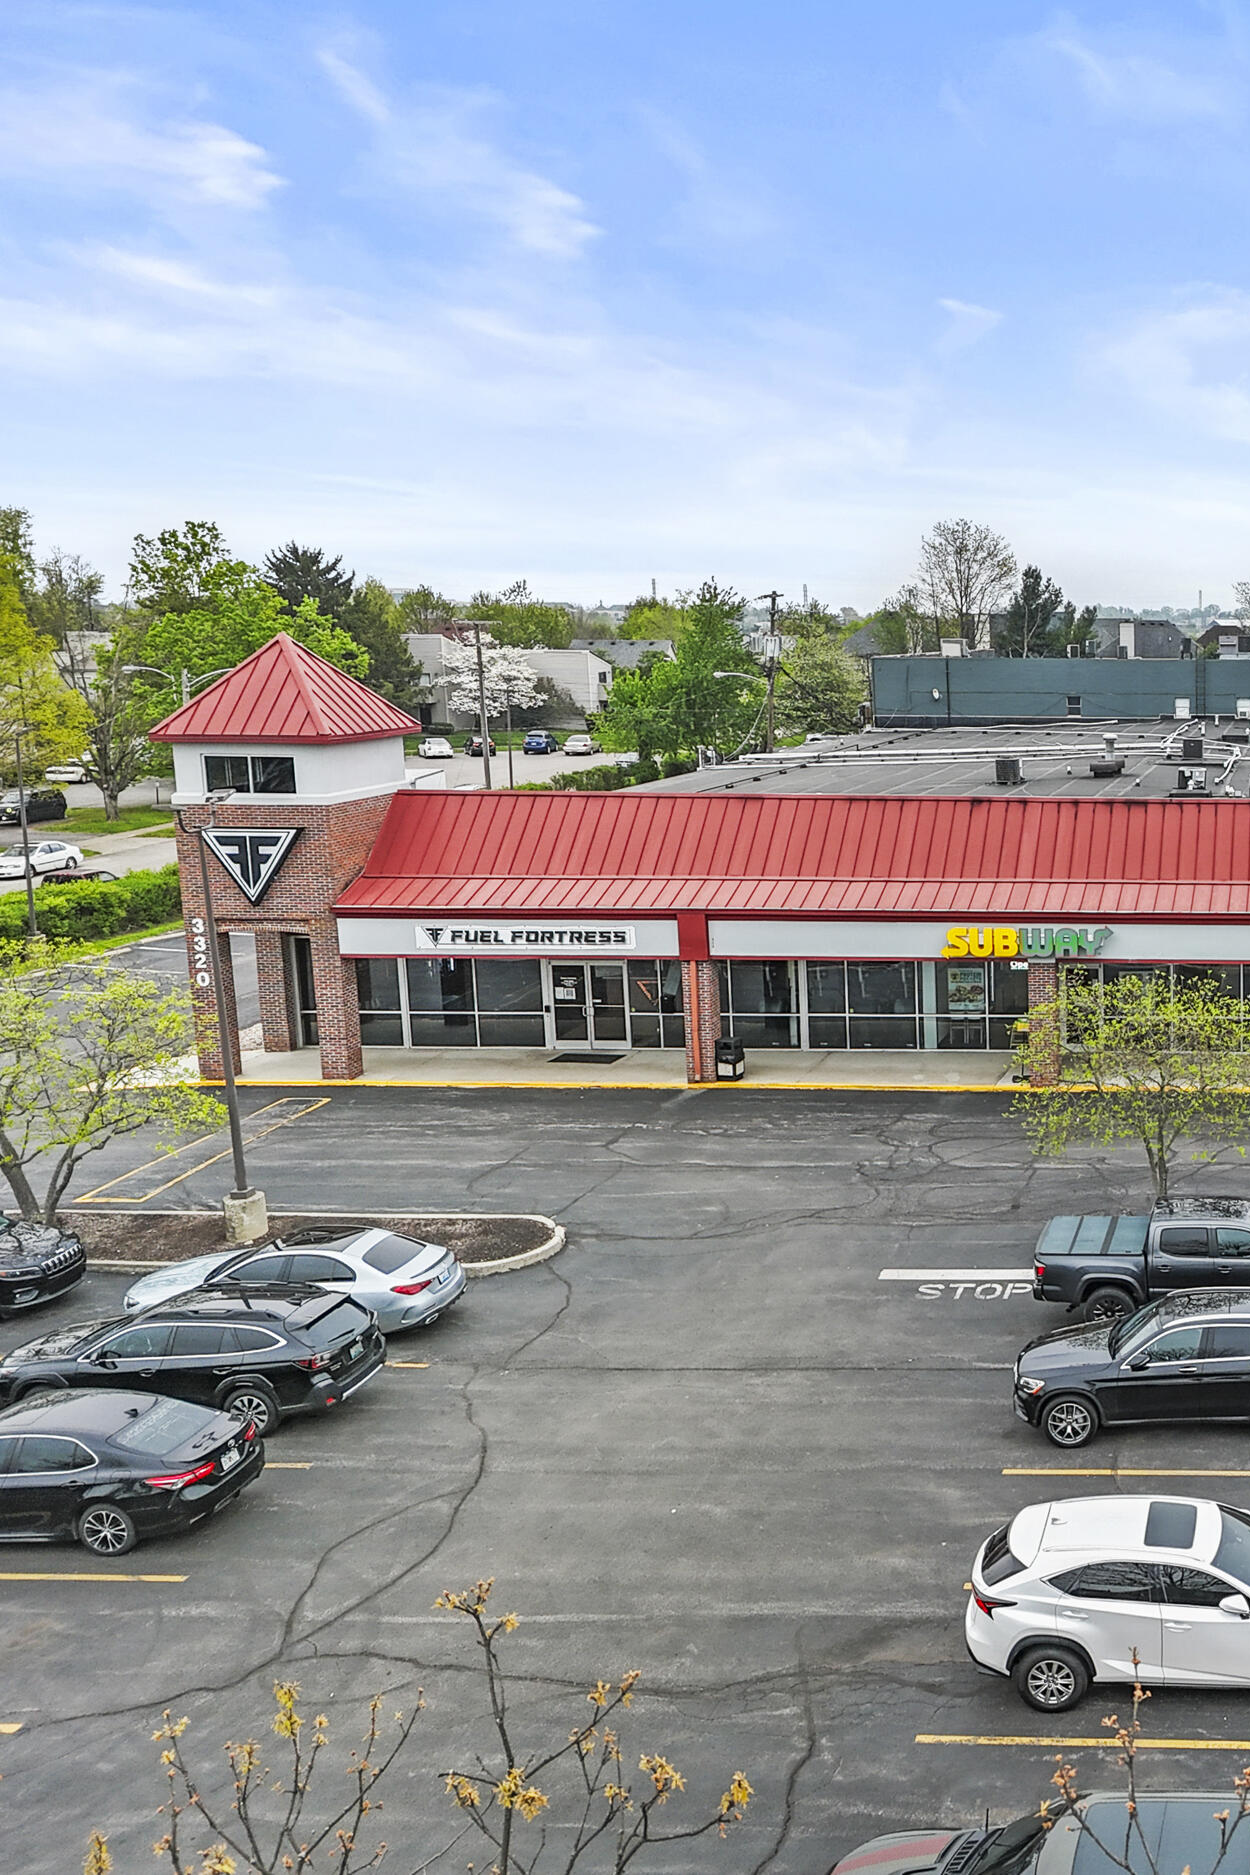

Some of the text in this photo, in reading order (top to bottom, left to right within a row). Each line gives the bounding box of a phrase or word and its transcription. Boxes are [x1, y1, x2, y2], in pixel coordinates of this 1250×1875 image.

[450, 930, 626, 944] FUEL FORTRESS
[940, 926, 1114, 959] SUBWAY
[191, 918, 210, 987] 3320
[1010, 961, 1029, 970] Ope
[917, 1283, 1033, 1300] STOP
